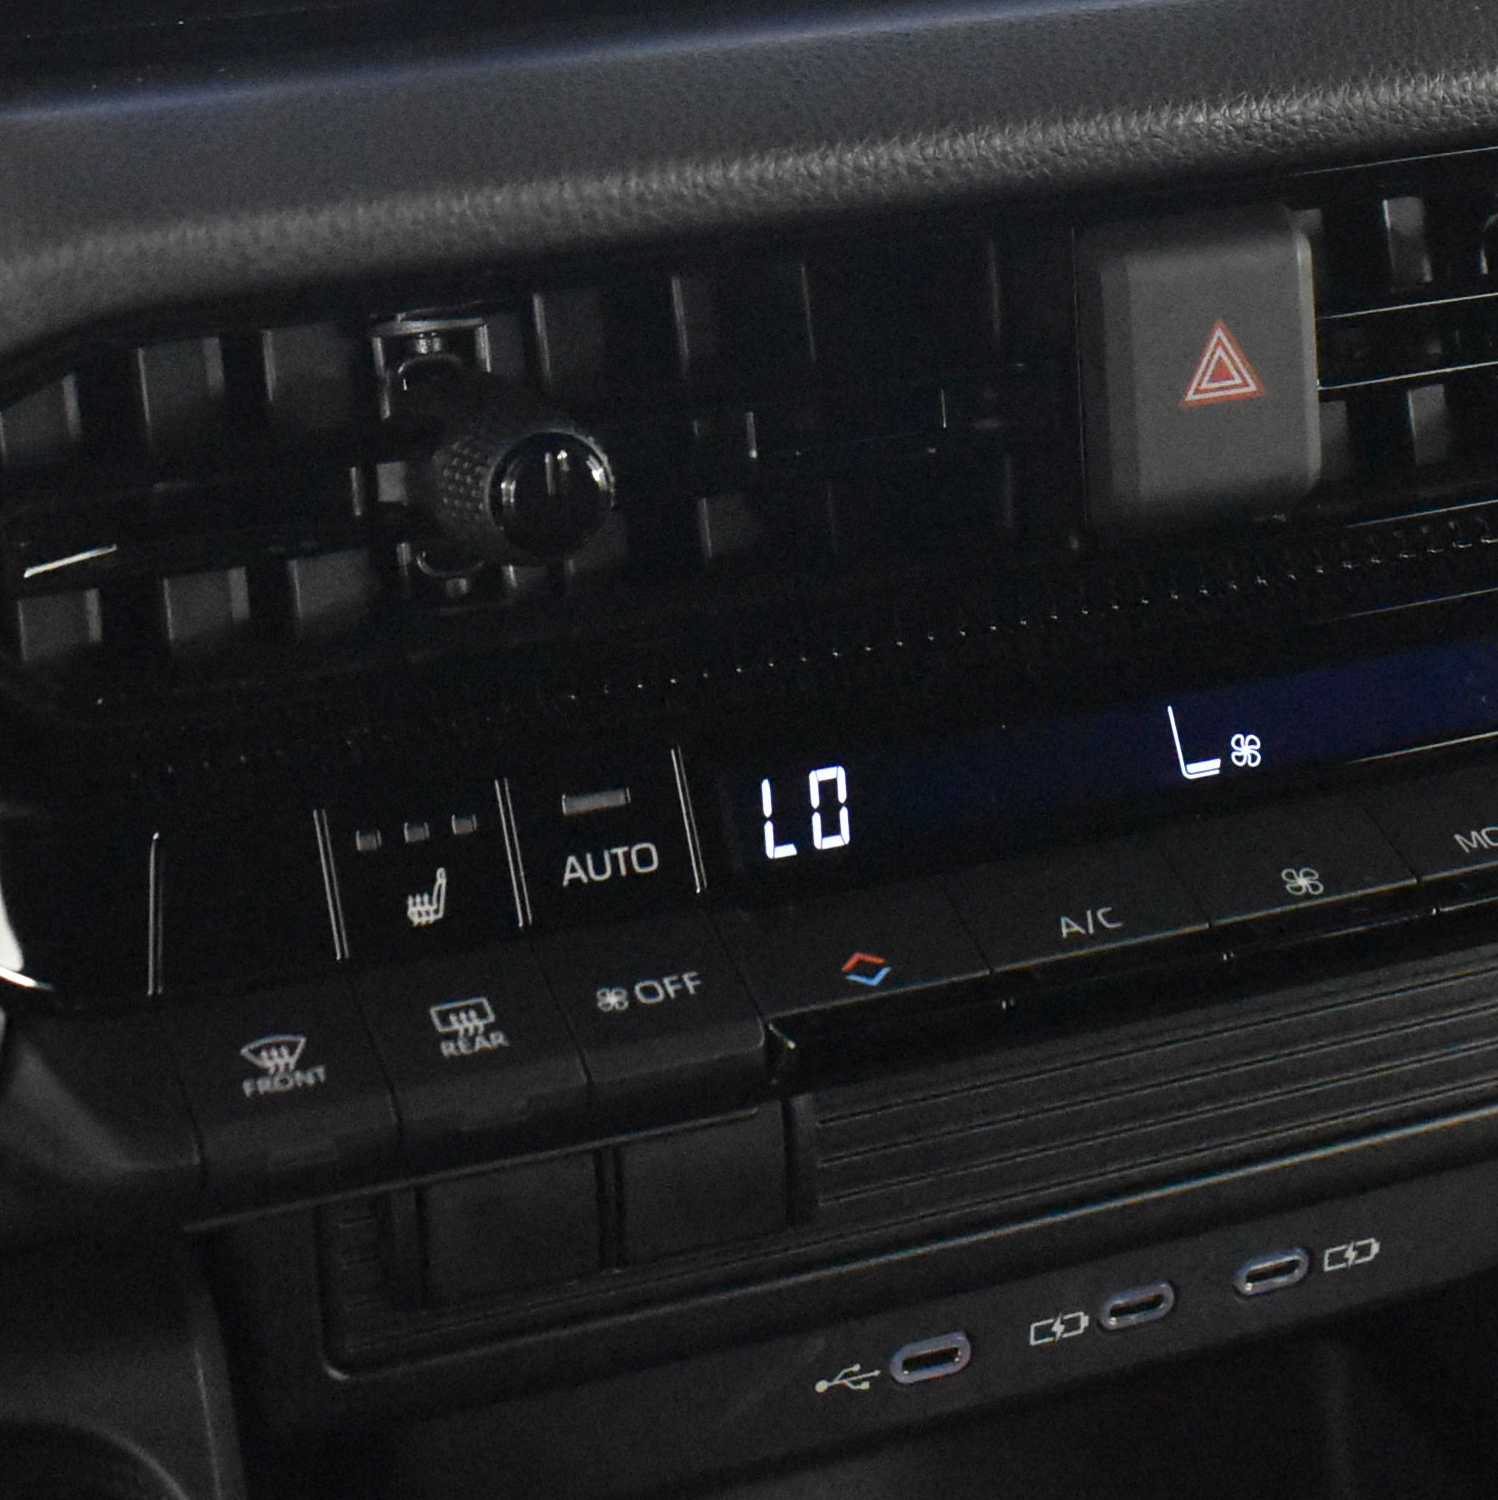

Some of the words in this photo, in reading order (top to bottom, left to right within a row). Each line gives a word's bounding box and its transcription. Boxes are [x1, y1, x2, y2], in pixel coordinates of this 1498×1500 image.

[563, 843, 658, 885] AUTO
[1061, 908, 1122, 938] A/C
[635, 972, 700, 1003] OFF
[439, 1030, 509, 1059] REAR
[242, 1065, 326, 1098] FRONT
